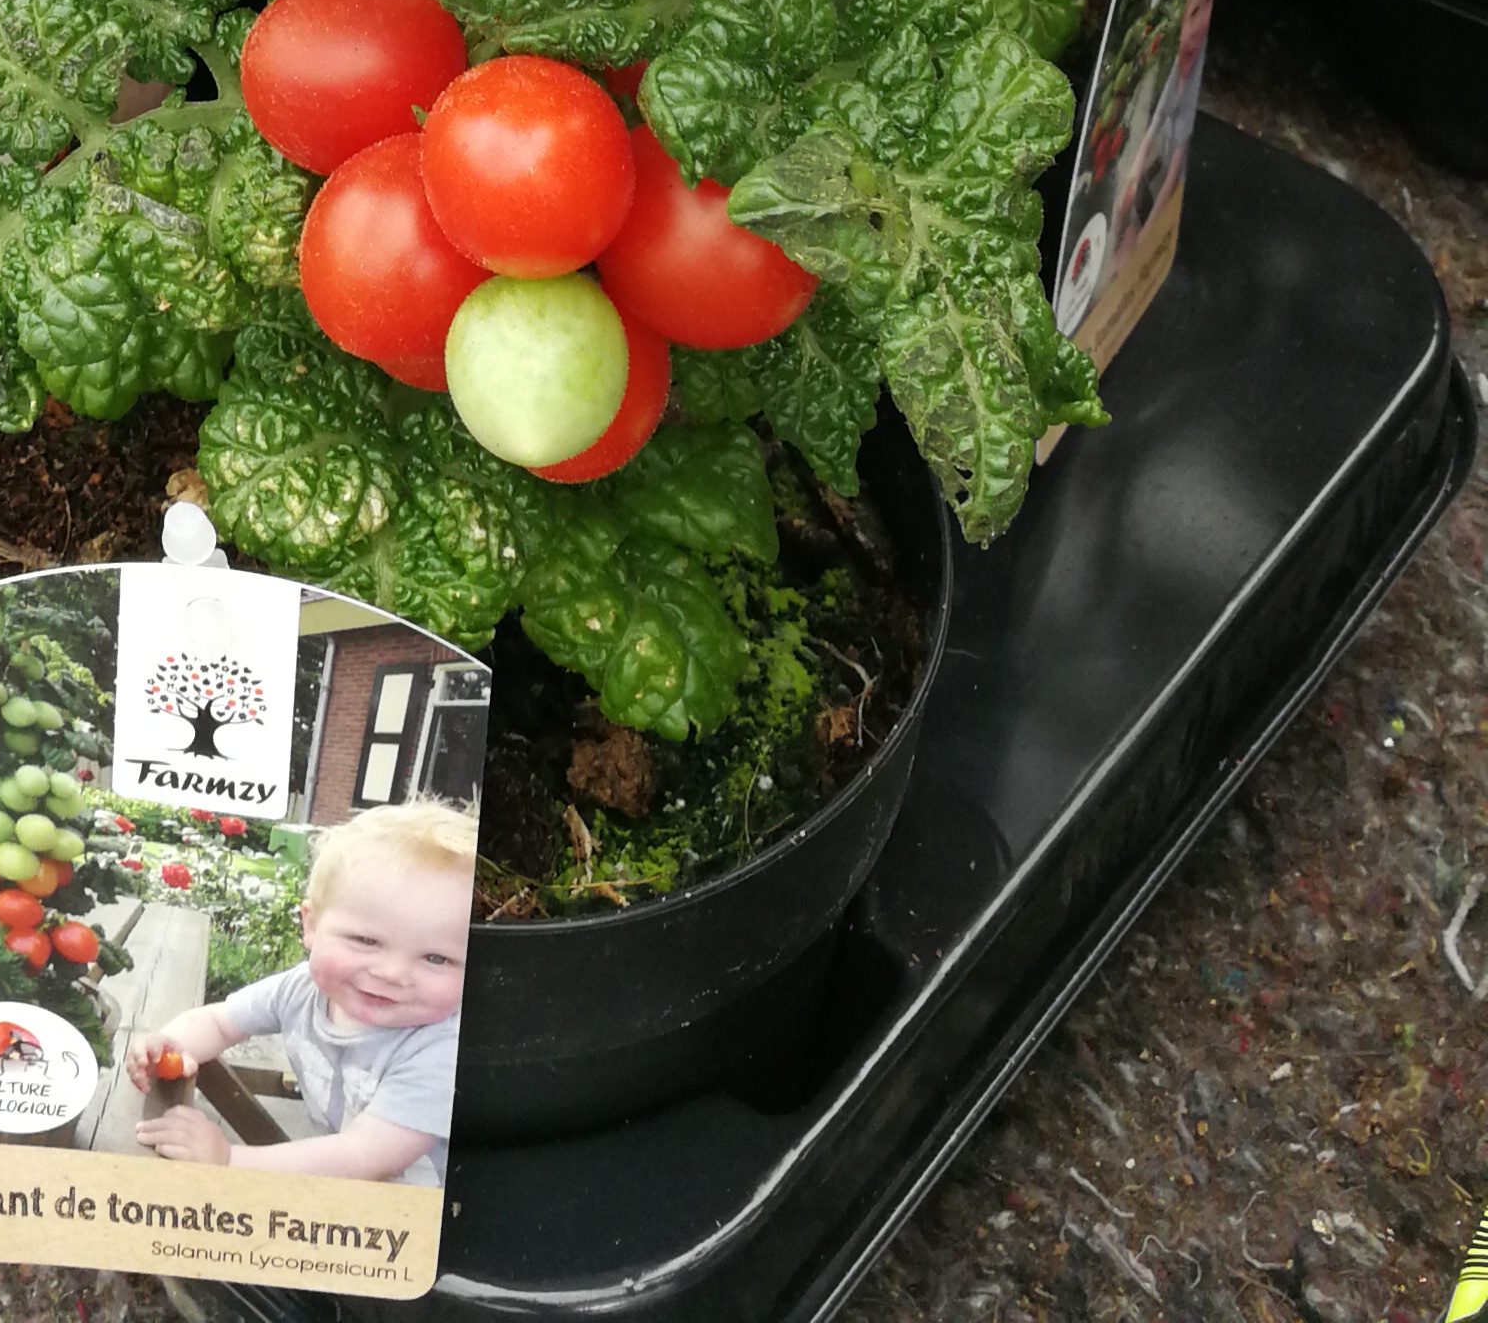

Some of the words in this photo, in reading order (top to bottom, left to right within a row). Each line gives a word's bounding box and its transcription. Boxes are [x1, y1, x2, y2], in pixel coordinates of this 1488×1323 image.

[54, 1186, 97, 1221] de
[107, 1193, 254, 1236] tomates
[268, 1209, 410, 1263] Farmzy
[150, 1240, 243, 1264] Solanum
[249, 1248, 397, 1280] Lycopersicum
